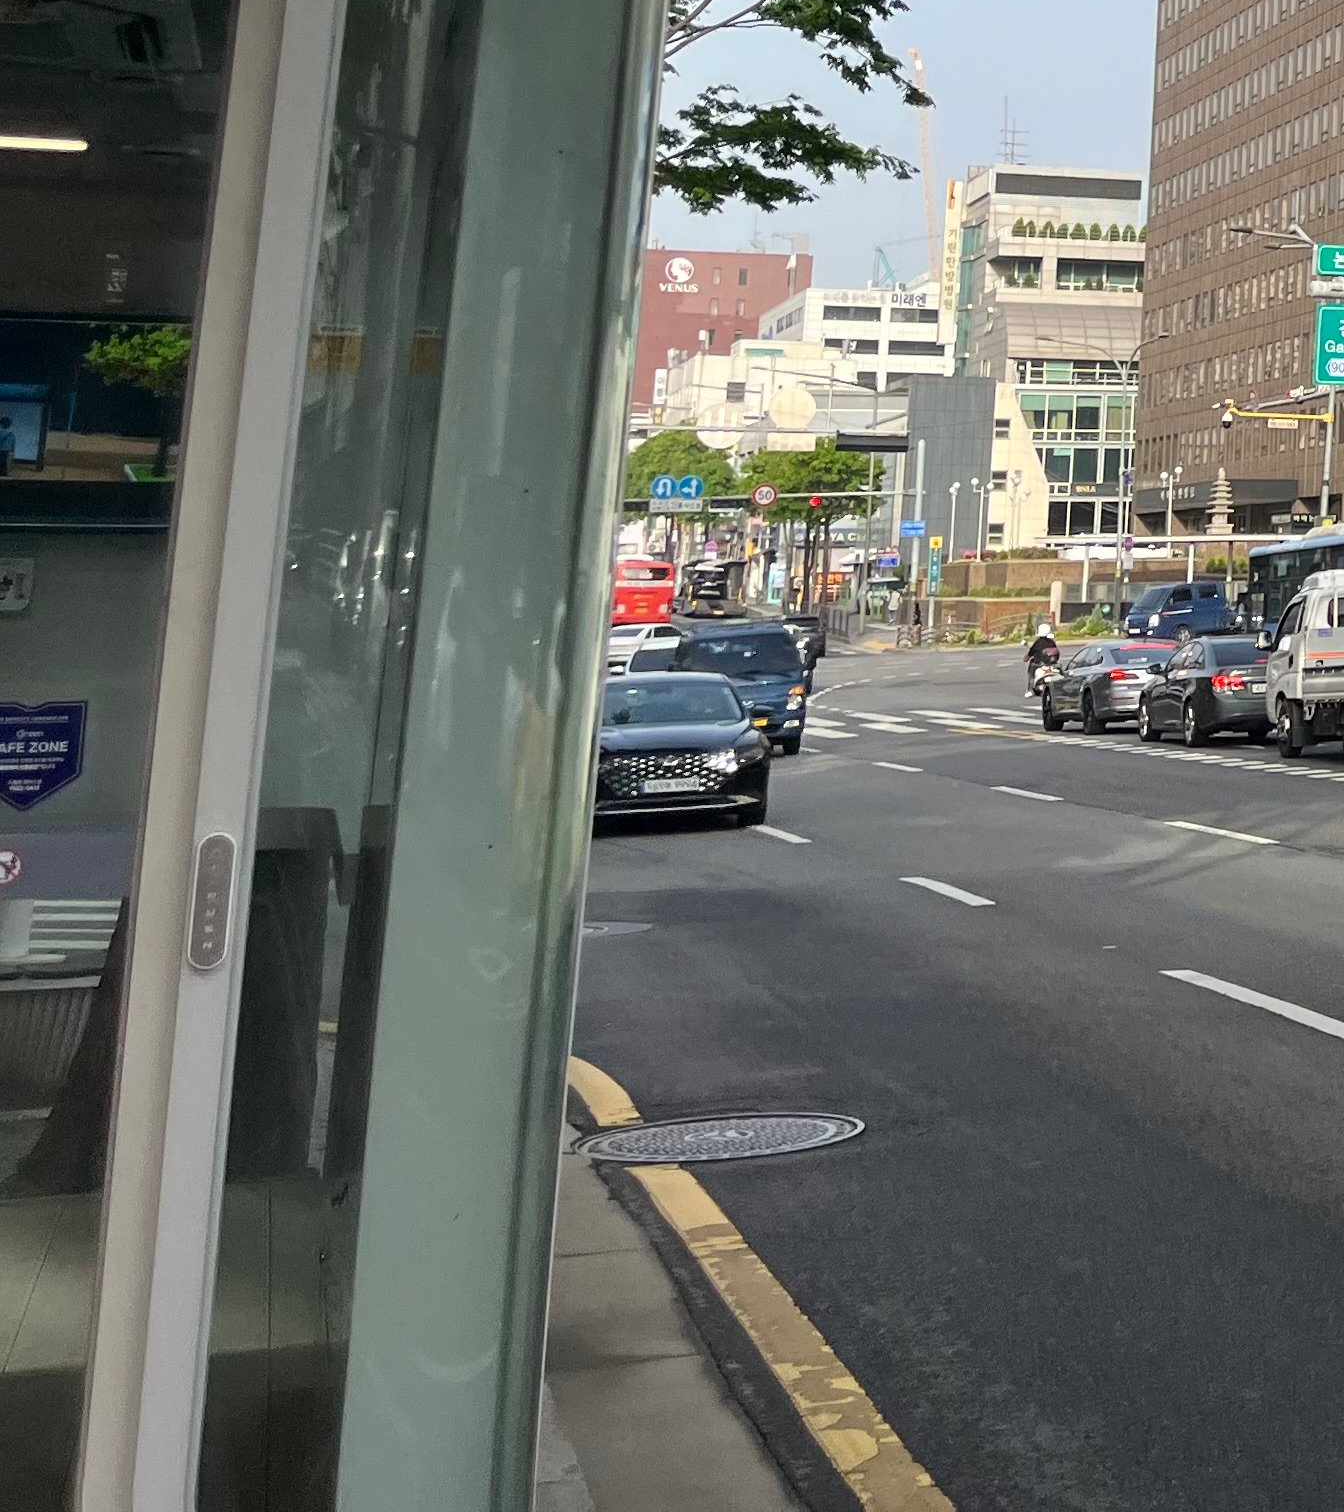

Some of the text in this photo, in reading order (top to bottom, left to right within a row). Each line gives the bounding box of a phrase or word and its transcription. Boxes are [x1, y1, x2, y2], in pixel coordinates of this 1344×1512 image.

[659, 283, 699, 293] VENUS
[891, 292, 927, 307] 미래엔
[757, 489, 772, 500] 50
[28, 740, 69, 754] ZONE
